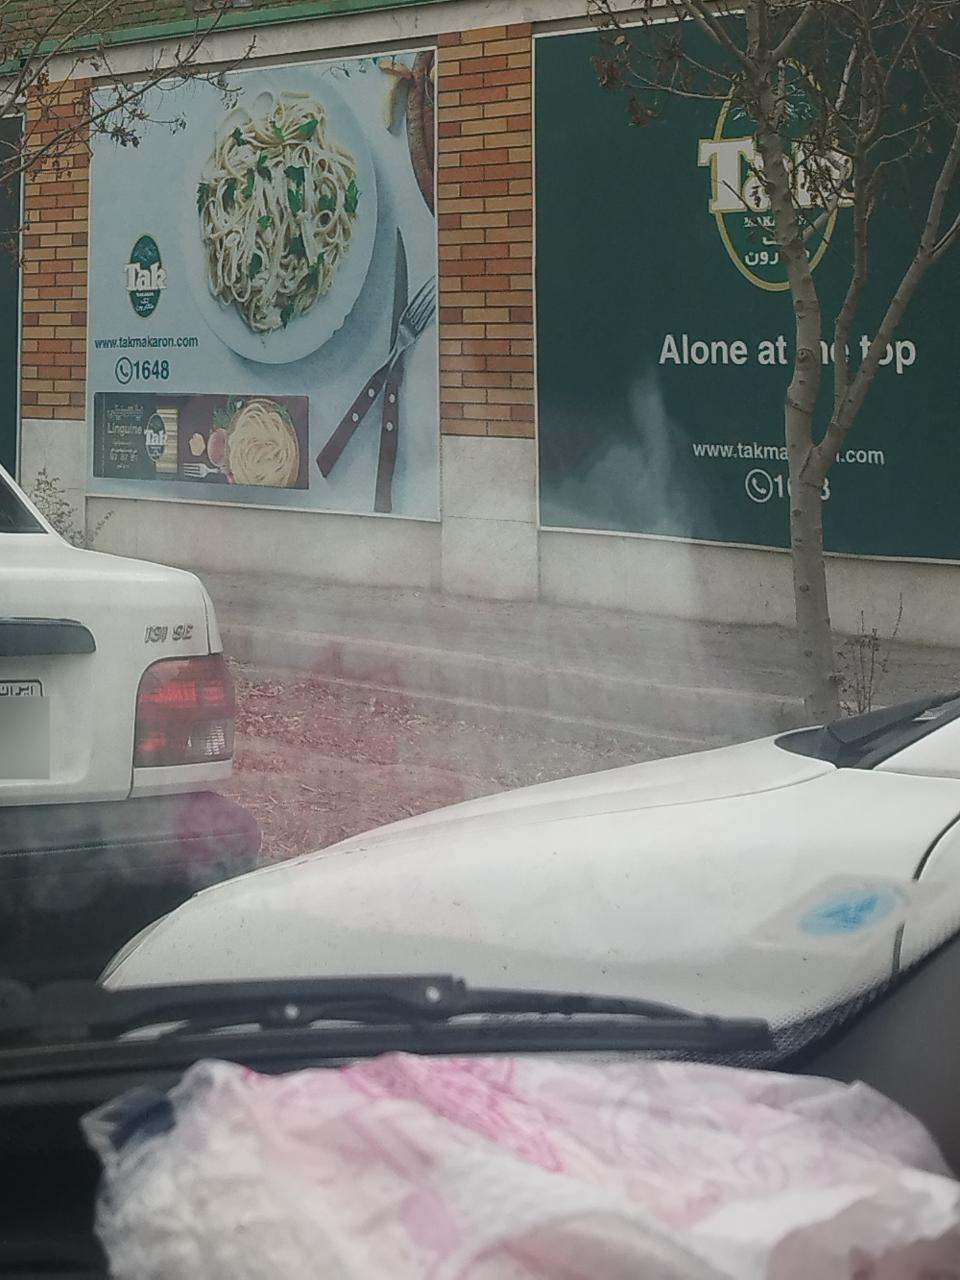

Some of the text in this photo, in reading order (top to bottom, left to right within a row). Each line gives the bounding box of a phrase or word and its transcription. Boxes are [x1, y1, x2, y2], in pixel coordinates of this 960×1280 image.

[125, 262, 167, 291] Tak
[94, 336, 198, 348] www.takmakaron.com
[658, 334, 748, 365] Alone
[757, 335, 788, 365] at
[133, 360, 170, 380] 1648
[172, 624, 194, 641] SE
